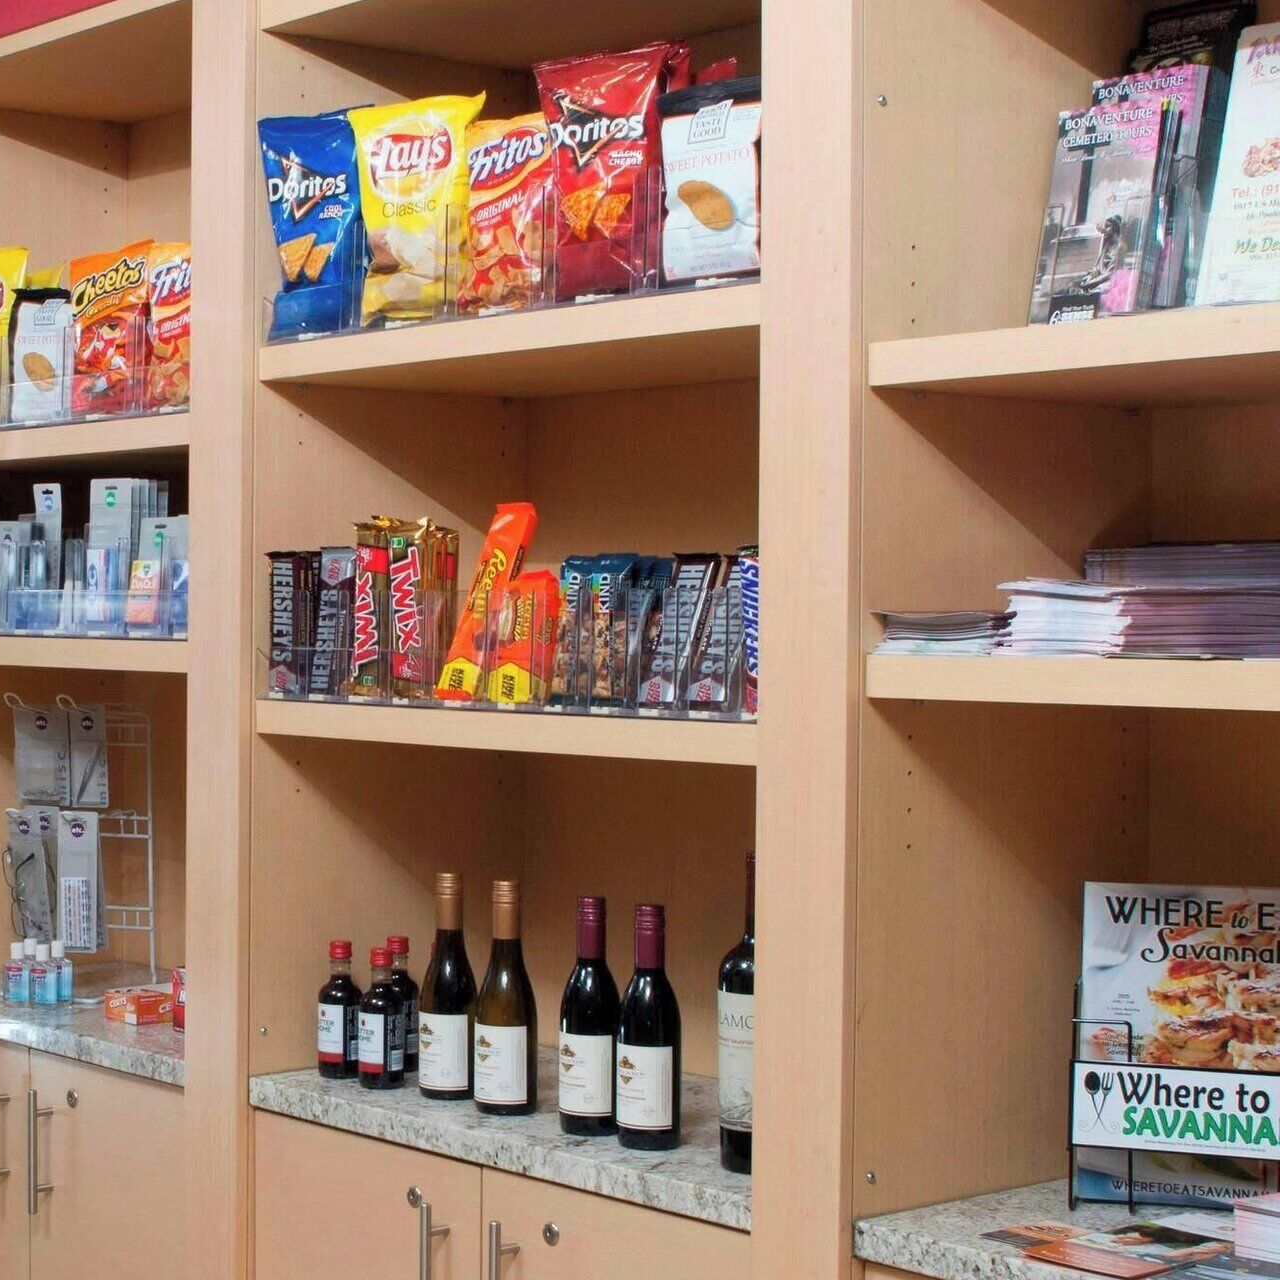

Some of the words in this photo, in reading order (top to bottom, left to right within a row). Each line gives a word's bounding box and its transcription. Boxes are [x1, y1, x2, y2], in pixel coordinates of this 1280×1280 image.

[1098, 75, 1185, 100] BONAVENTURE
[549, 115, 644, 149] Doritos
[693, 128, 721, 140] GOOD
[1063, 131, 1112, 149] CEMETERY
[1118, 126, 1152, 140] TOURS
[1065, 108, 1153, 130] BONAVENTURE
[370, 130, 452, 179] Lay's
[470, 131, 549, 185] Fritos
[701, 147, 751, 168] POTATO
[268, 174, 347, 203] Doritos
[477, 191, 524, 221] ORIGINAL
[382, 198, 437, 219] Classic
[73, 258, 147, 317] Cheetos
[390, 546, 421, 653] TWIX
[566, 573, 580, 612] KIND
[599, 573, 610, 613] KIND
[272, 562, 293, 662] HERSHEY'S
[353, 572, 378, 676] TWIX
[311, 589, 338, 689] HERSHEY'S
[507, 674, 516, 700] KING
[1105, 895, 1223, 928] WHERE
[1231, 912, 1251, 929] to
[1140, 927, 1280, 964] Savanna
[1117, 1071, 1224, 1111] Where
[1236, 1083, 1270, 1114] to
[1122, 1106, 1280, 1147] SAVANNA
